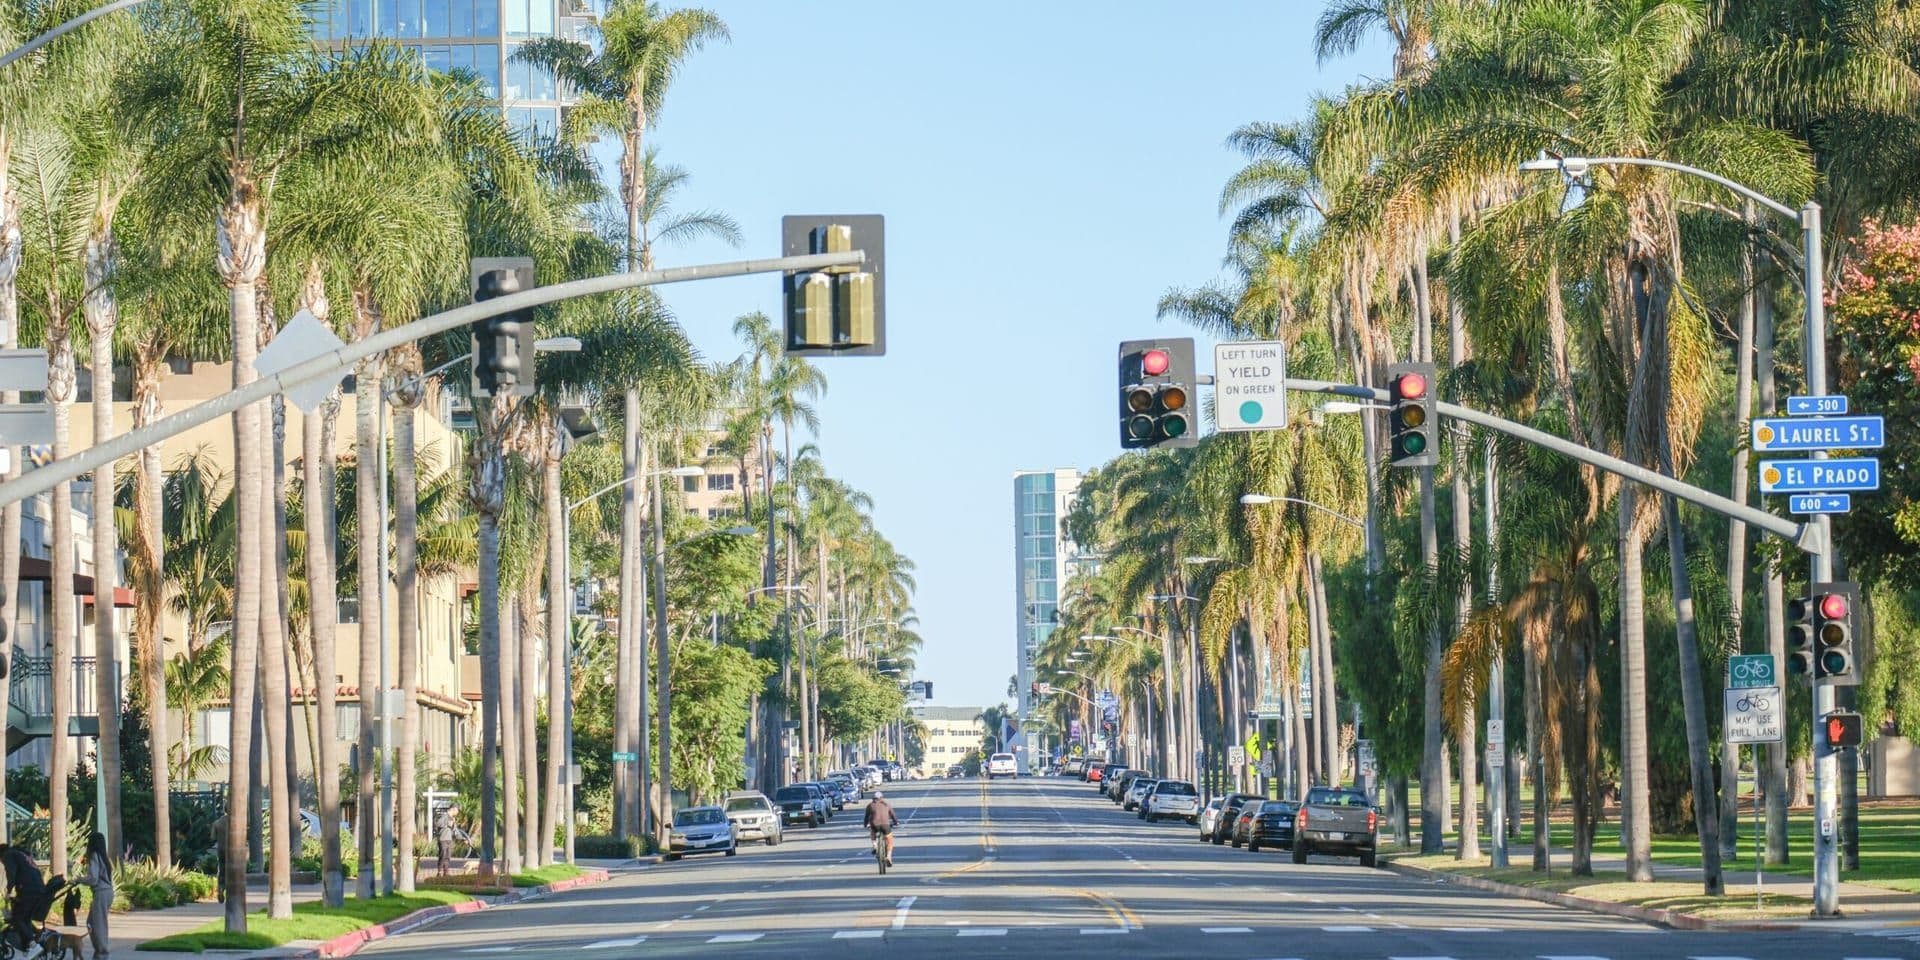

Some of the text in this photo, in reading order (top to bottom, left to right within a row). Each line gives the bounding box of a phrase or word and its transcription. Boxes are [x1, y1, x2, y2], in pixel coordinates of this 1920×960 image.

[1222, 349, 1276, 360] LEFT TURN
[1229, 366, 1271, 378] YIELD
[1226, 385, 1275, 395] ON GREEN
[1817, 399, 1839, 411] 500
[1780, 426, 1841, 443] LAUREL
[1786, 466, 1869, 484] EL PRADO
[1800, 498, 1821, 511] 600
[1735, 715, 1772, 724] MAY USE
[1731, 727, 1777, 737] FULL LANE
[1231, 755, 1243, 763] 30
